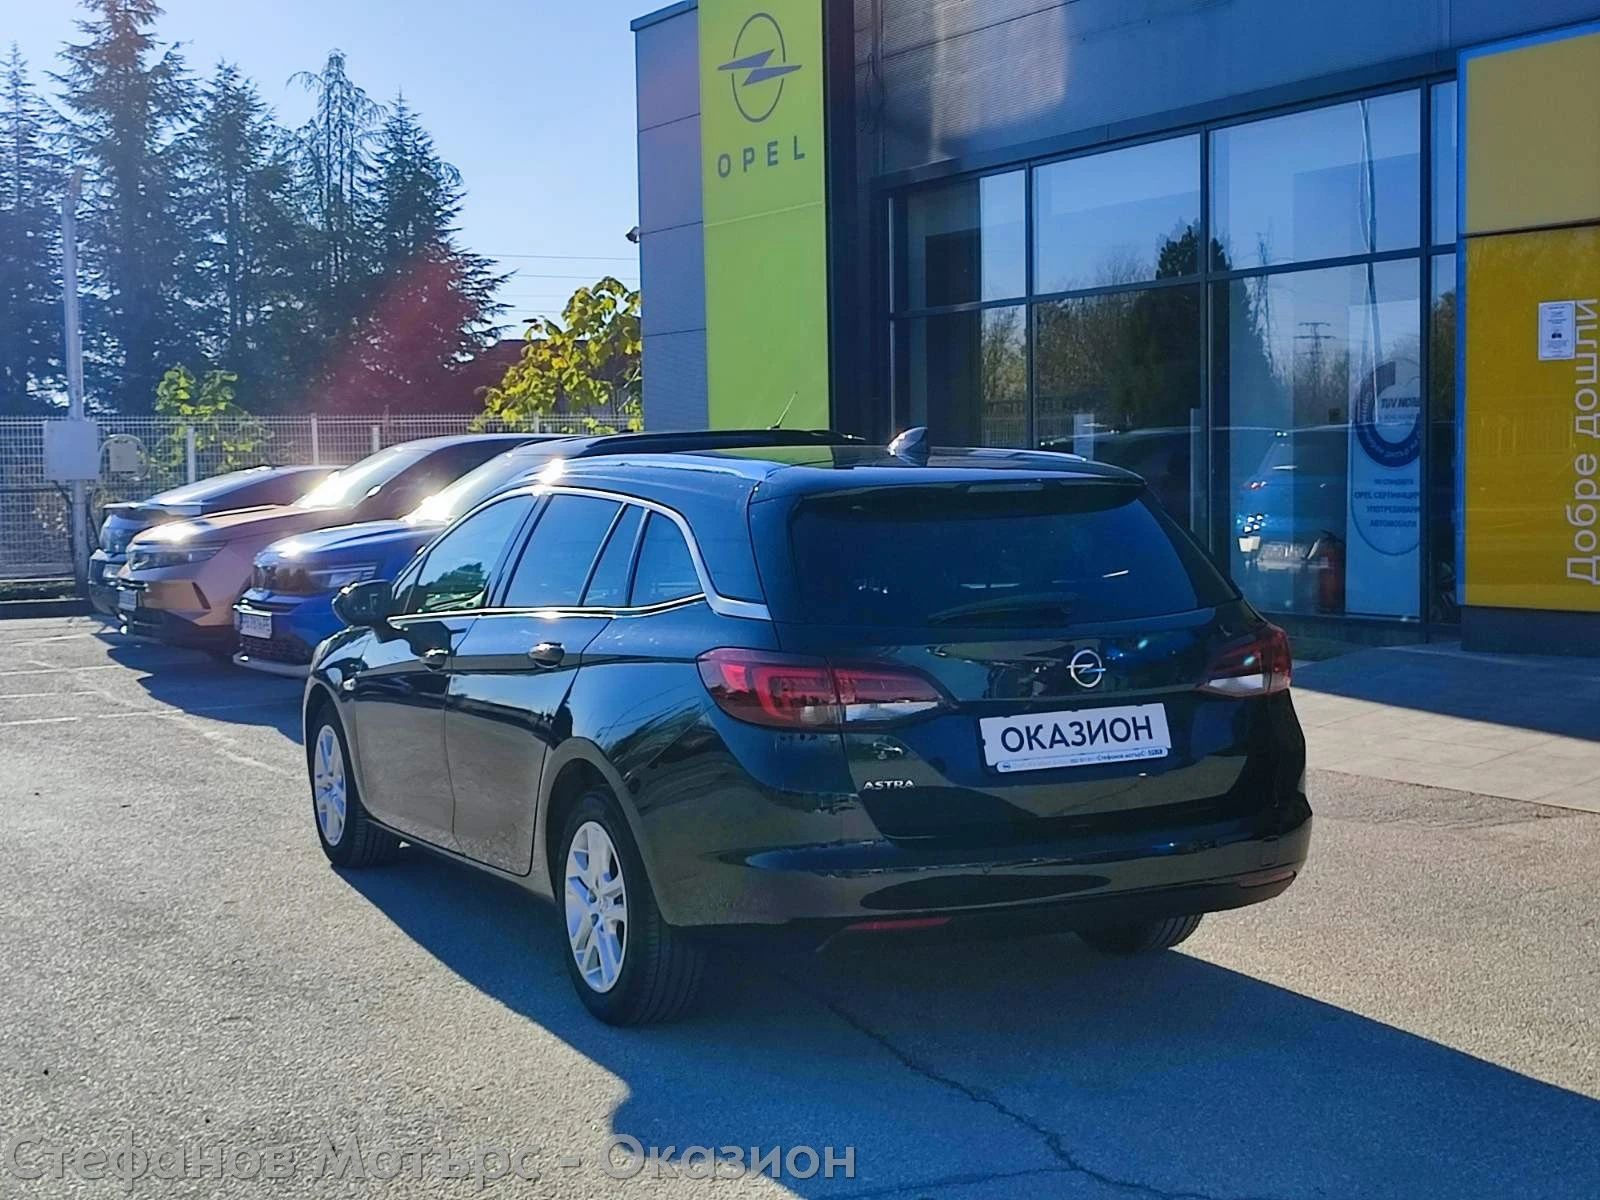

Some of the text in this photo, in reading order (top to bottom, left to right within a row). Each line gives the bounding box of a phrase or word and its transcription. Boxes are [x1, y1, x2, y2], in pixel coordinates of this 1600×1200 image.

[718, 135, 805, 178] OPEL
[1567, 299, 1600, 585] Добре дошли
[1001, 715, 1153, 752] ОКАЗИОН
[864, 780, 914, 789] ASTRA
